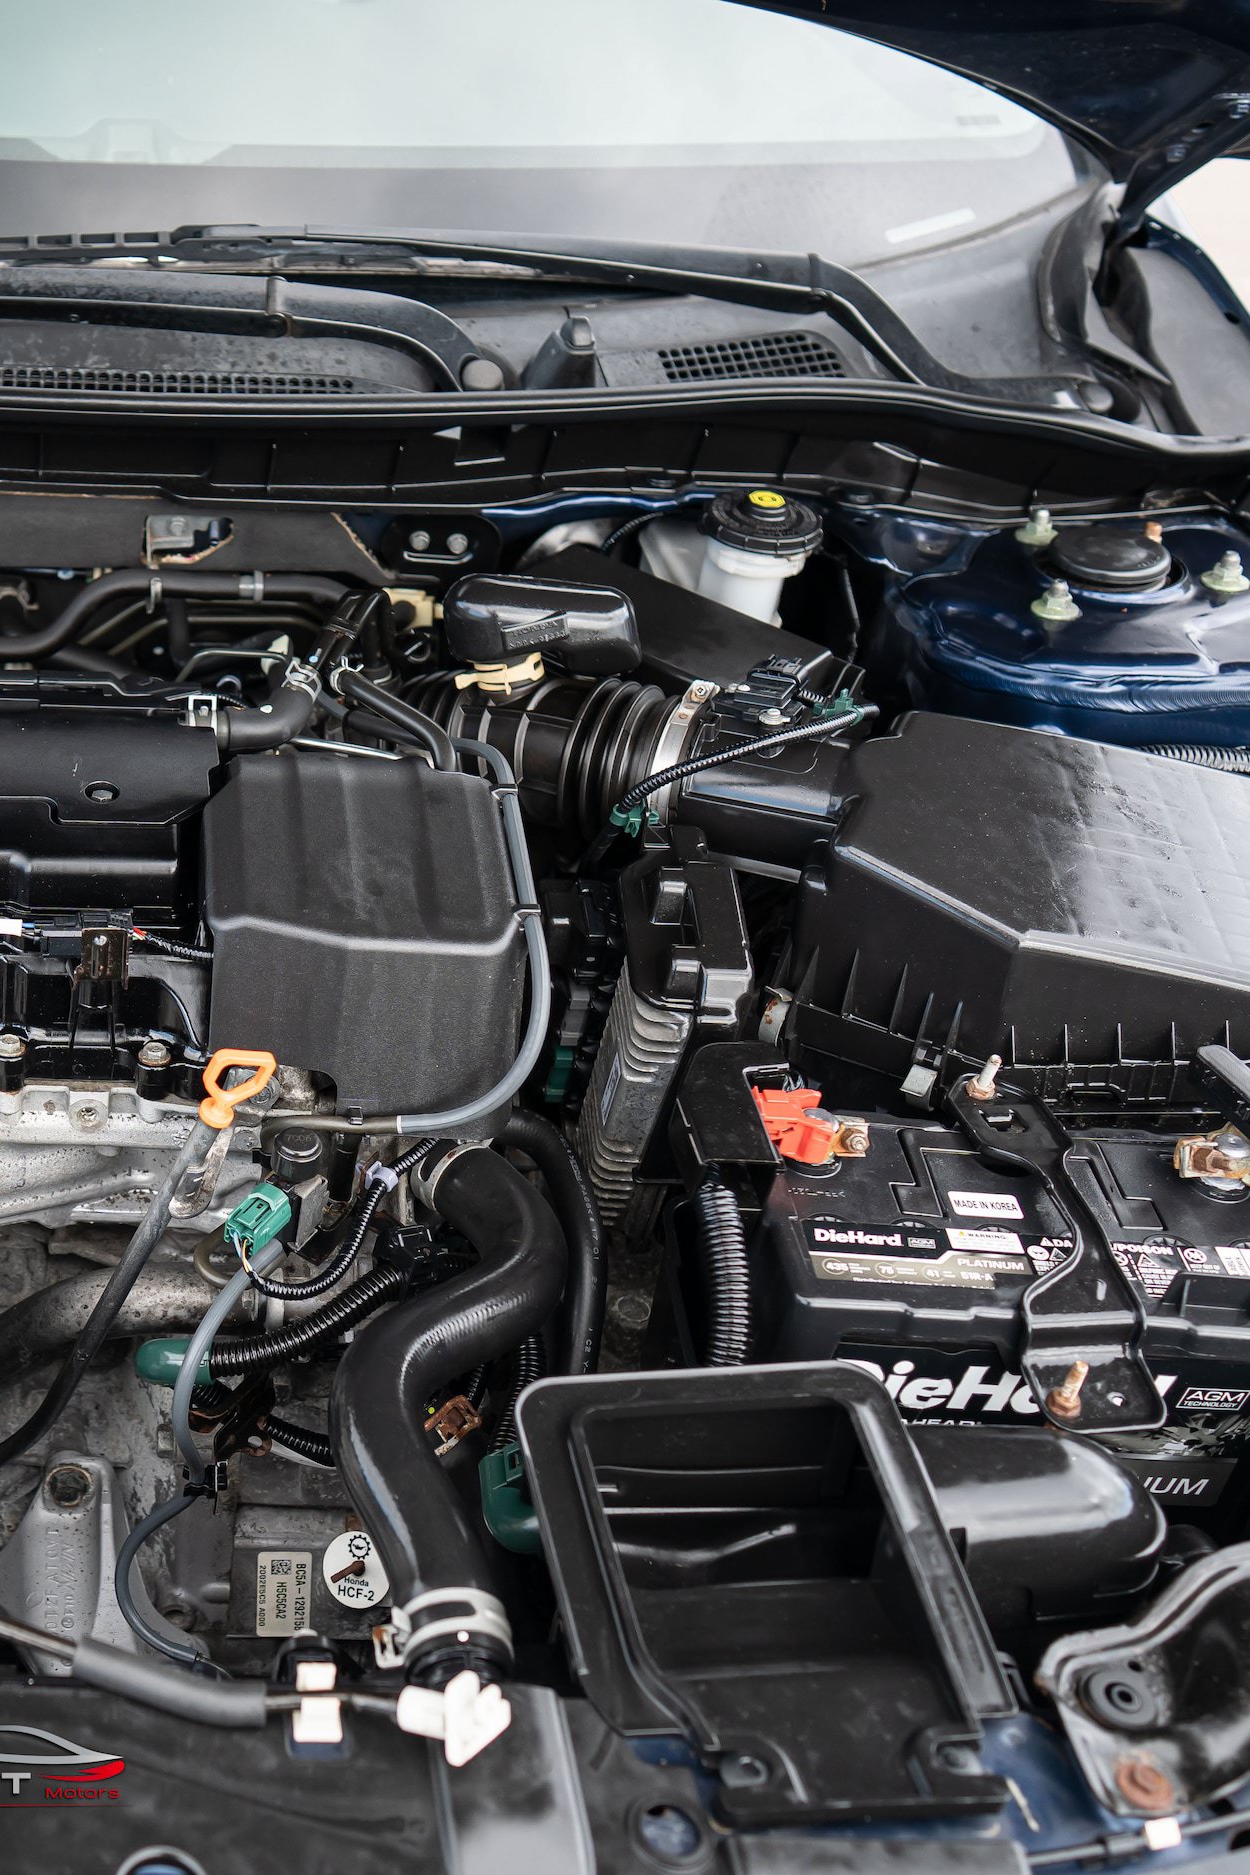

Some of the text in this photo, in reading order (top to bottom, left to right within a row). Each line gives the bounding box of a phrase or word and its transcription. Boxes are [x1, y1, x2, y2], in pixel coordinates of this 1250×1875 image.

[953, 1199, 1019, 1212] MADE IN KOREA
[813, 1228, 903, 1247] DieHard
[826, 1261, 849, 1271] 435
[957, 1258, 1025, 1271] PLATINUM
[1187, 1390, 1246, 1402] AGM
[1183, 1400, 1239, 1408] TECHNOLOGY
[344, 1577, 369, 1587] Honda
[337, 1585, 375, 1602] HCF-2
[275, 1581, 287, 1620] H5C5CA2
